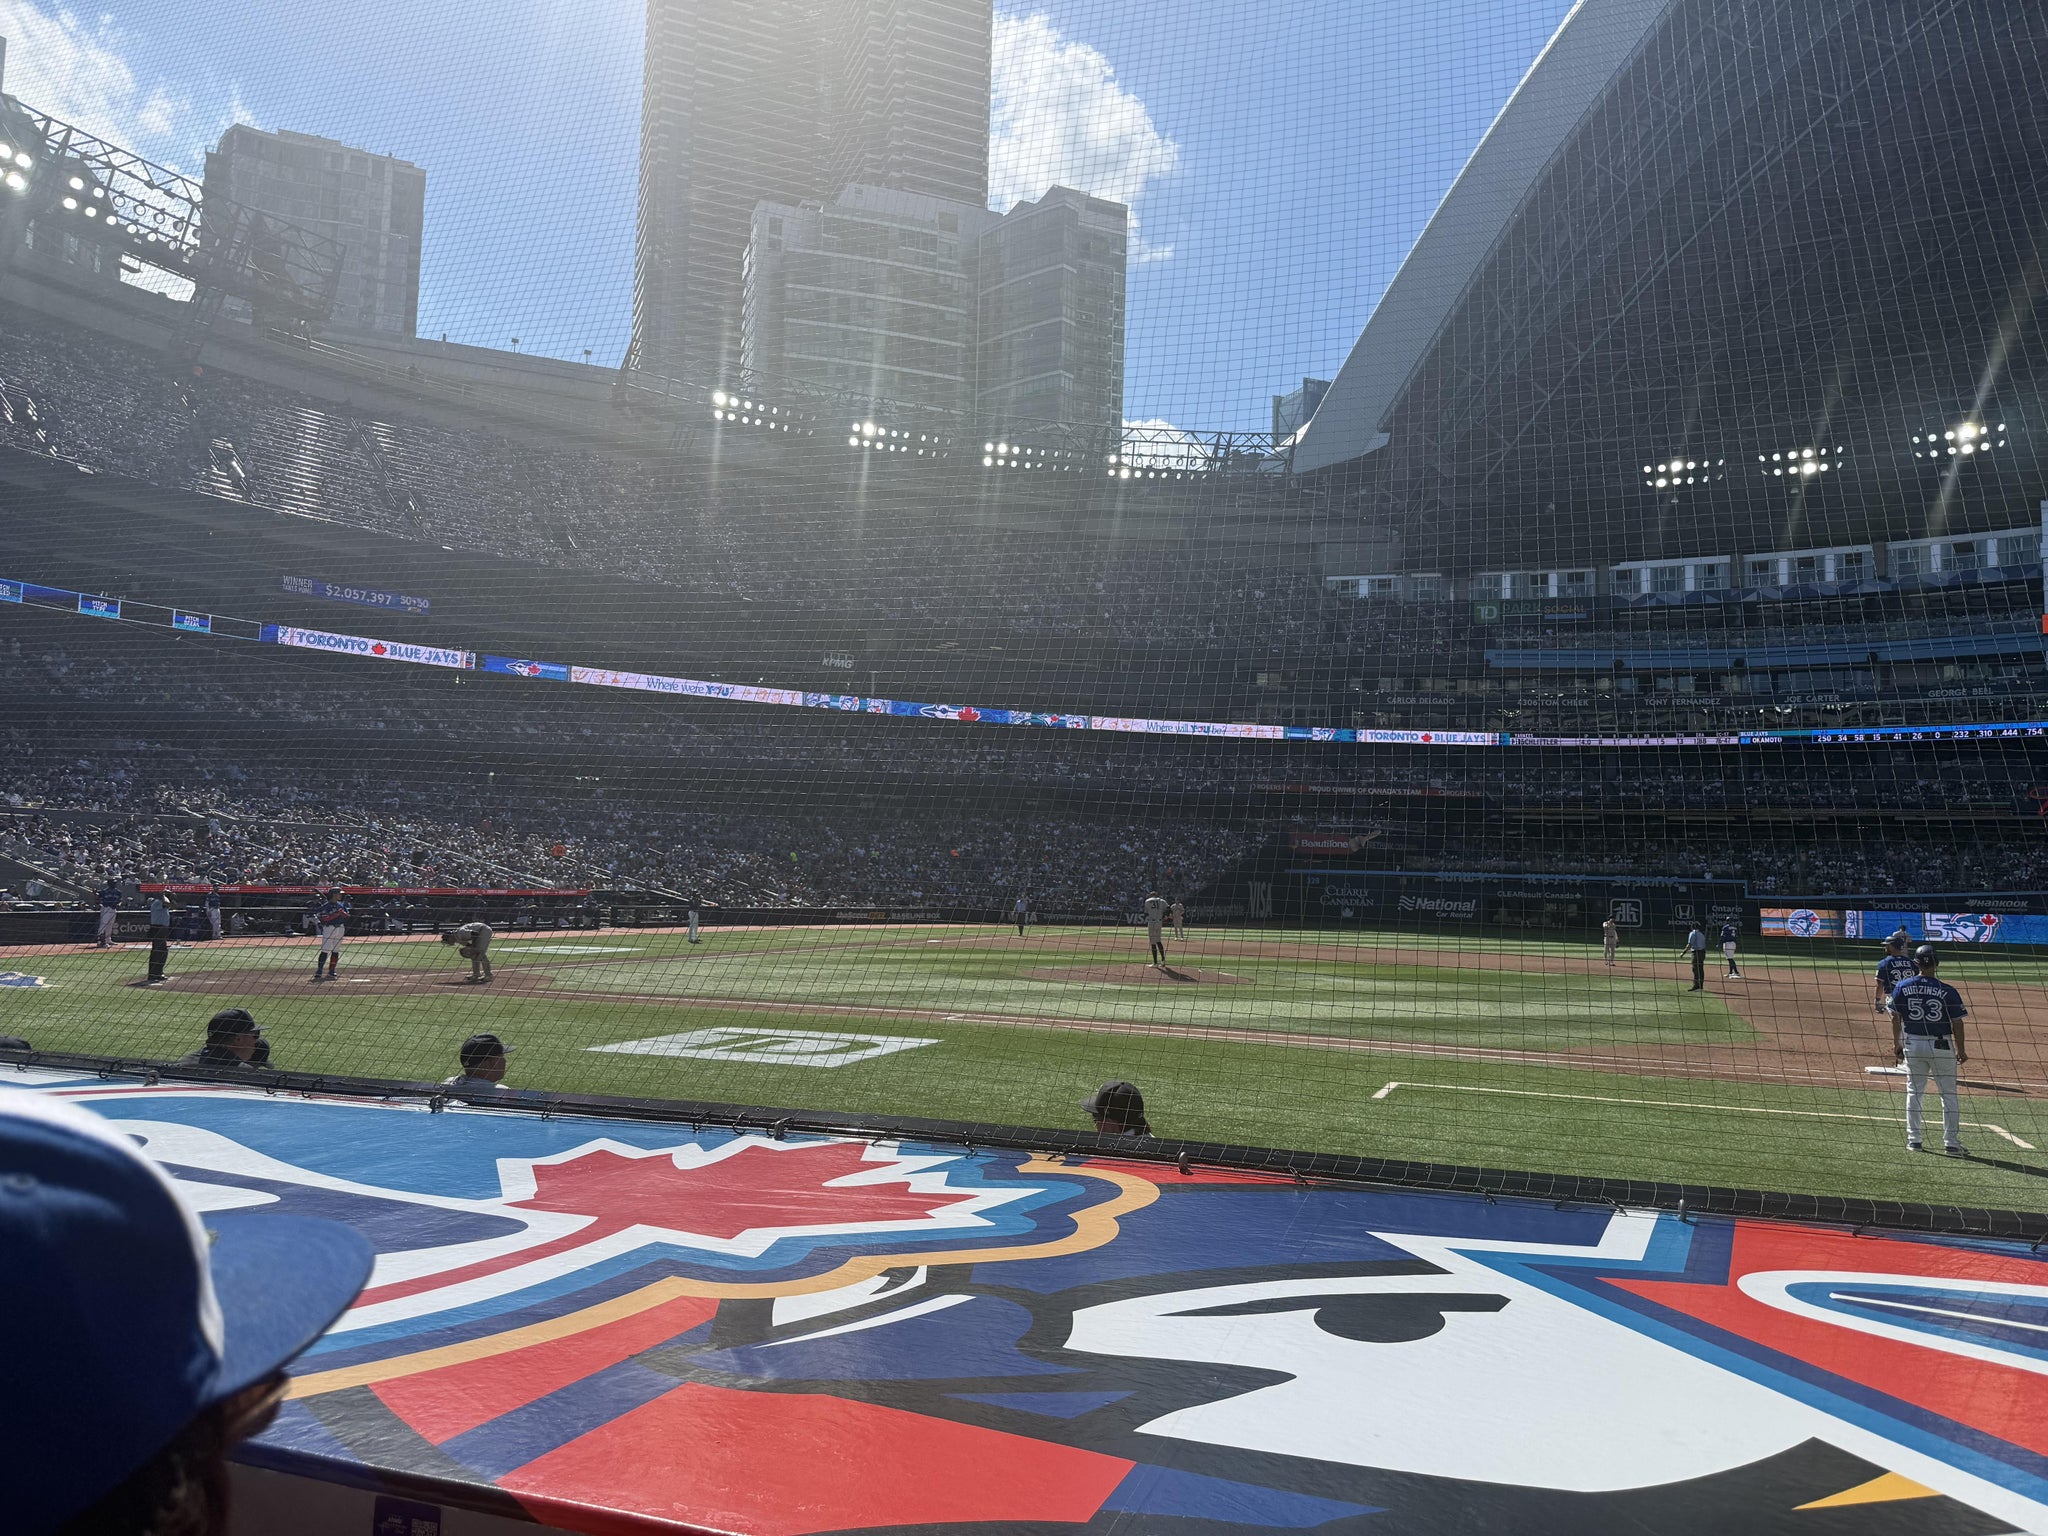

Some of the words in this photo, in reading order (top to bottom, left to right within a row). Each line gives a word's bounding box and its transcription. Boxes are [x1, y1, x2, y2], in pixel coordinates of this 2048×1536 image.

[1476, 605, 1498, 620] TD
[297, 631, 369, 652] TORONTO
[389, 644, 422, 661] BLUE
[425, 650, 459, 666] JAYS
[822, 657, 854, 669] KPMG
[646, 676, 679, 691] Where
[1784, 695, 1802, 703] JOE
[1806, 694, 1841, 702] CARTER
[1928, 688, 1968, 698] GEORGE
[1972, 687, 1994, 695] BELL
[1386, 696, 1417, 704] CARLOS
[1419, 697, 1456, 705] DELGADO
[1645, 698, 1669, 706] TONY
[1672, 697, 1721, 706] FERNANDEZ
[1368, 731, 1419, 741] TORONTO
[1434, 733, 1457, 743] BLUE
[1460, 734, 1486, 743] JAYS
[1893, 733, 1902, 741] 41
[1912, 732, 1922, 740] 26
[1934, 731, 1941, 739] 0
[2025, 729, 2043, 738] .754
[1325, 885, 1370, 897] CLEARLY
[1497, 890, 1541, 899] CLEAResult
[1247, 880, 1273, 918] VISA
[1320, 895, 1375, 906] CANADIAN
[1415, 897, 1477, 911] National
[1712, 904, 1743, 912] Ontario
[119, 922, 151, 933] clove
[1891, 960, 1912, 968] LUKES
[1902, 985, 1948, 999] BUDZINSKI
[1908, 998, 1943, 1022] 53
